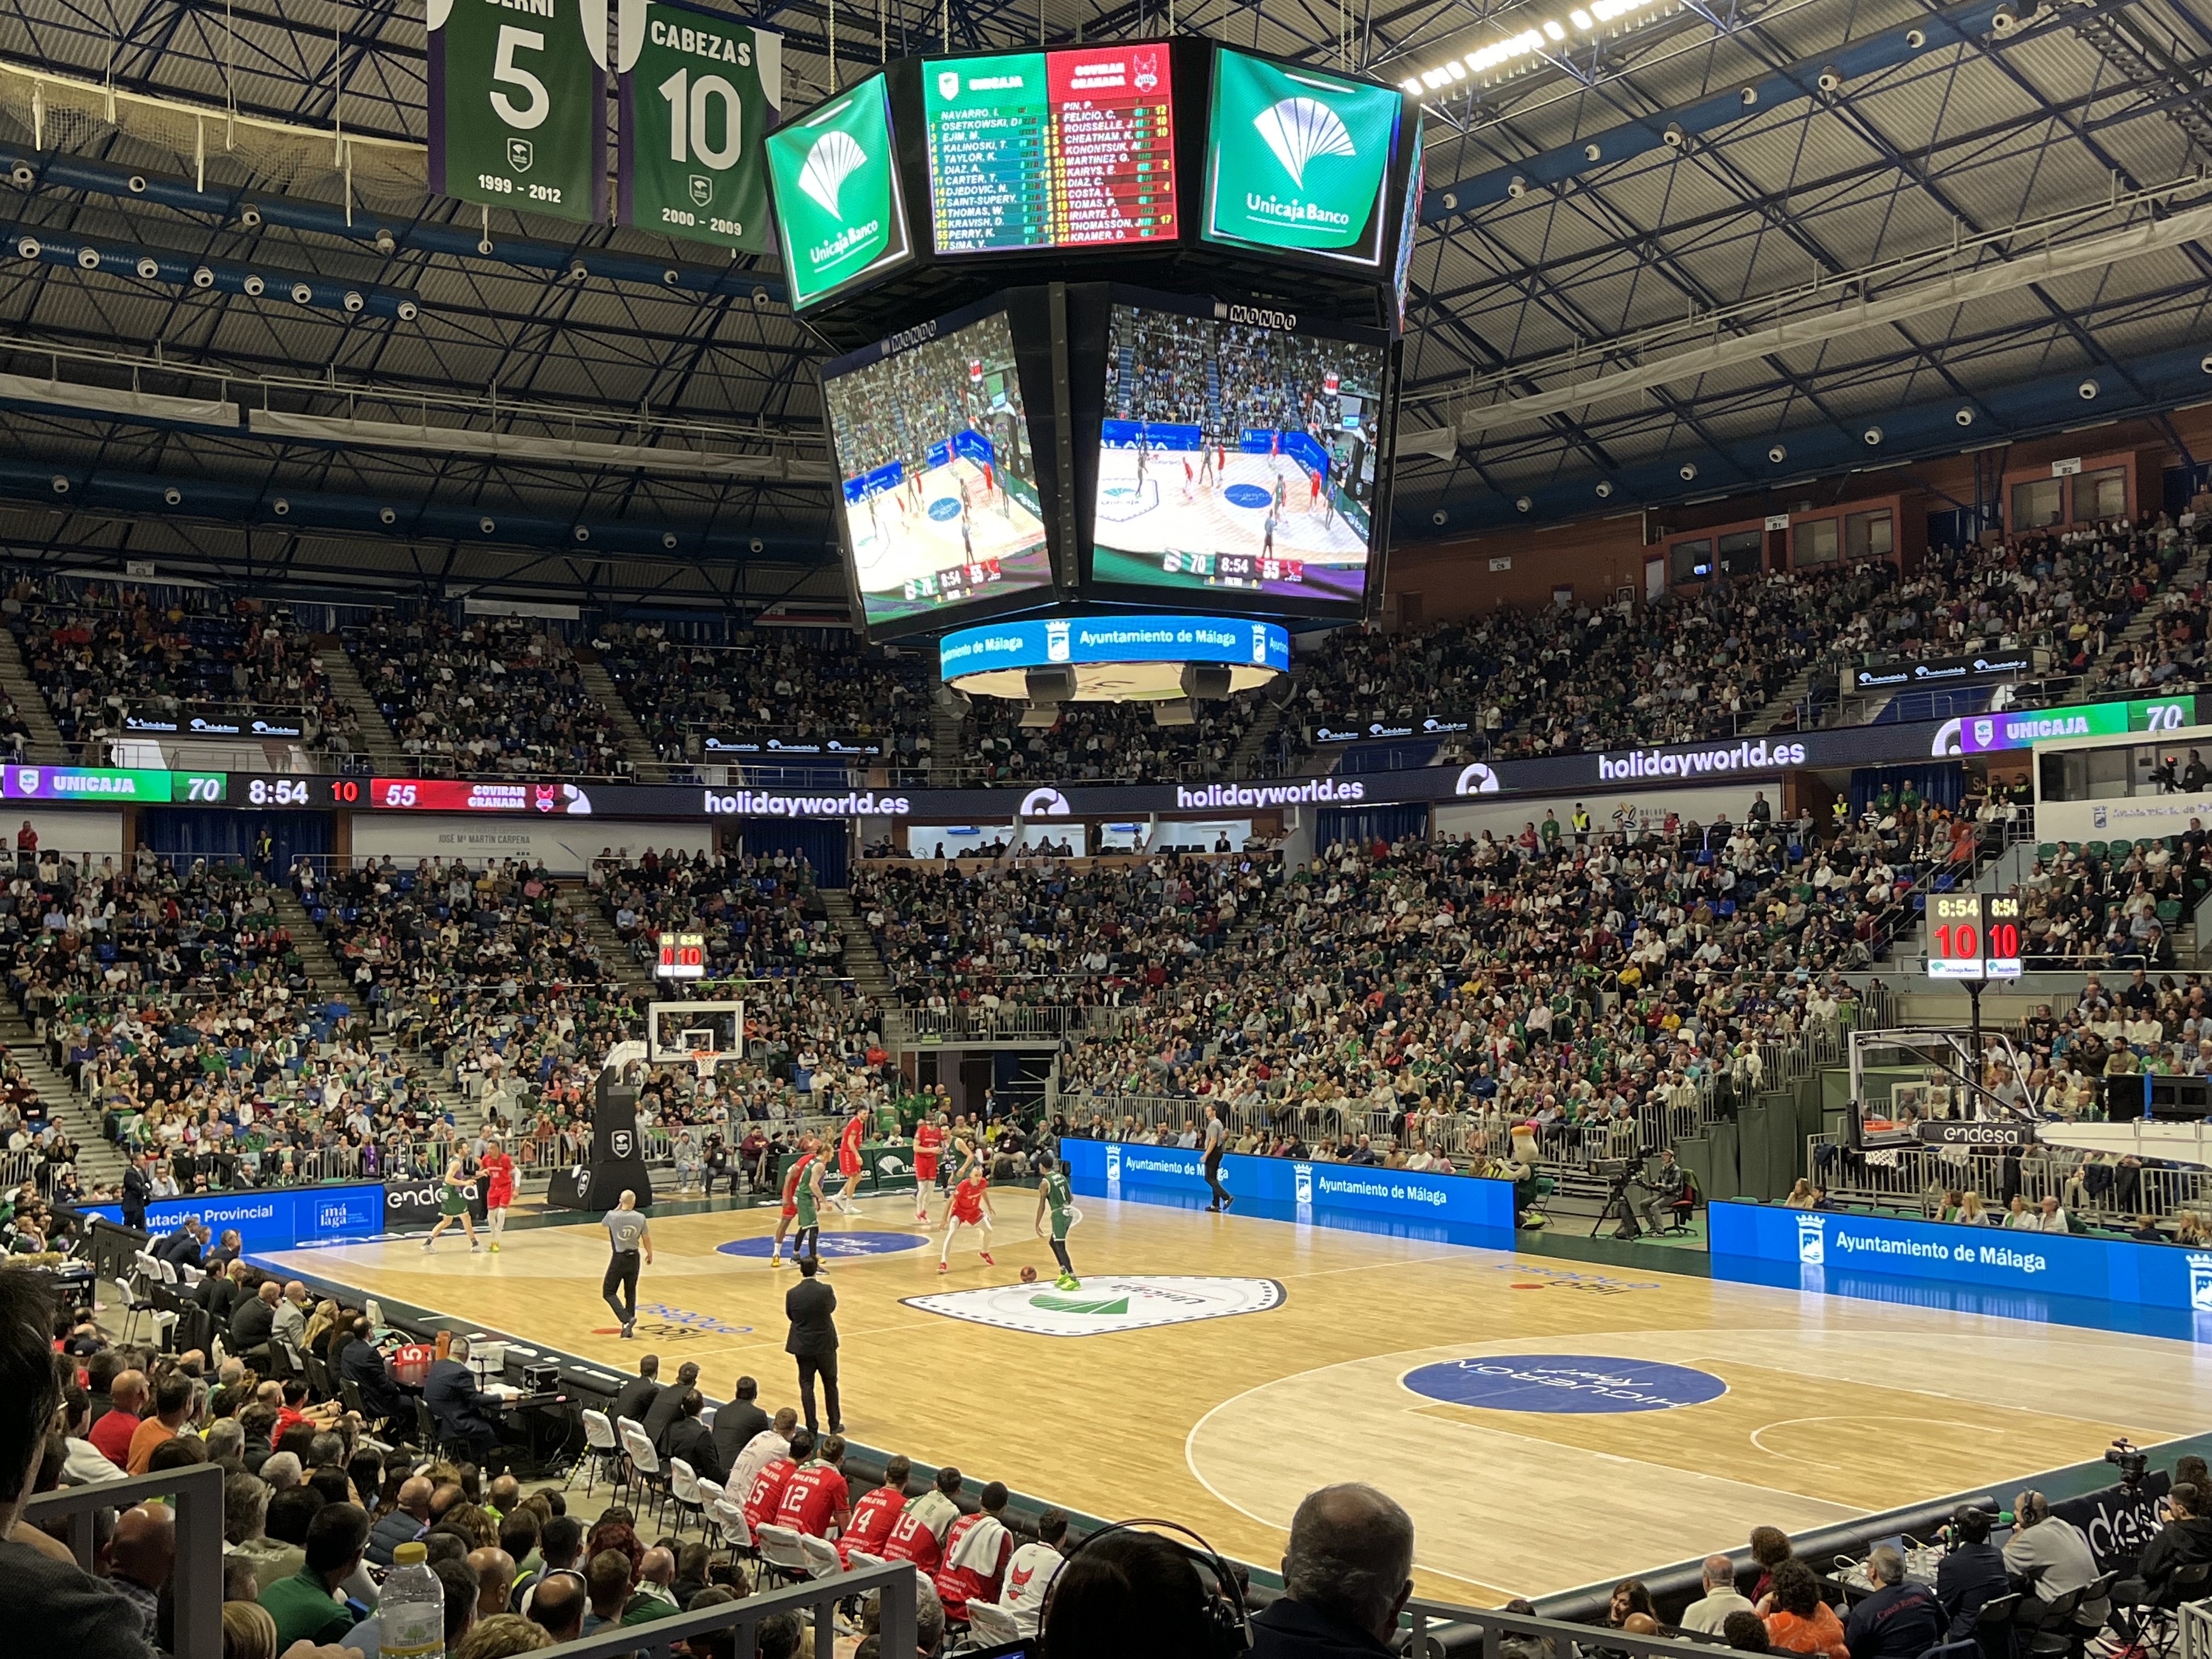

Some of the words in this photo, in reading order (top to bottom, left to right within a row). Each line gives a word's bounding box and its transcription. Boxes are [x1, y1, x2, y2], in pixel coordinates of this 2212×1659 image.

[651, 20, 752, 67] CABEZAS
[490, 25, 549, 129] 5
[658, 67, 741, 170] 10
[478, 174, 512, 193] 1999
[529, 184, 561, 204] 2012
[662, 208, 695, 227] 2000
[710, 217, 742, 236] 2009
[1246, 193, 1305, 221] Unicaja
[1306, 203, 1348, 225] Banco
[810, 232, 849, 263] Unicaja
[848, 219, 878, 245] Banco
[1230, 304, 1296, 330] MONDO
[890, 320, 937, 353] MONDO
[1190, 555, 1206, 573] 70
[1221, 557, 1249, 573] 8:54
[1263, 560, 1279, 579] 55
[973, 641, 984, 654] de
[985, 637, 1023, 652] Málaga
[1080, 629, 1174, 645] Ayuntamiento
[1178, 629, 1193, 643] de
[1195, 629, 1235, 647] Málaga
[2007, 716, 2089, 740] UNICAJA
[2147, 704, 2184, 732] 70
[1599, 740, 1805, 780] holidayworld.es
[54, 775, 136, 794] UNICAJA
[188, 778, 219, 801] 70
[249, 779, 308, 804] 8:54
[331, 781, 358, 802] 10
[386, 784, 416, 806] 55
[467, 796, 526, 808] GRANADA
[704, 790, 910, 817] holidayworld.es
[1177, 778, 1364, 808] holidayworld.es
[438, 833, 454, 843] JOSÉ
[498, 835, 531, 844] CARPENA
[1938, 899, 1978, 917] 8:54
[1991, 899, 2018, 916] 8:54
[1934, 924, 1977, 958] 10
[1989, 924, 2017, 958] 10
[661, 947, 673, 965] 10
[678, 947, 701, 965] 10
[1944, 1125, 2018, 1144] endesa
[1125, 1156, 1183, 1176] Ayuntamiento
[1184, 1161, 1195, 1175] de
[1319, 1177, 1389, 1198] Ayuntamiento
[1391, 1184, 1404, 1199] de
[1407, 1184, 1447, 1205] Málaga
[205, 1204, 273, 1222] Provincial
[1836, 1231, 1950, 1260] Ayuntamiento
[1954, 1239, 1976, 1262] de
[1979, 1246, 2046, 1273] Málaga
[1494, 1263, 1661, 1289] endesa
[1544, 1280, 1632, 1295] liga
[747, 1477, 769, 1505] 15
[791, 1472, 820, 1486] PULEVA
[781, 1484, 809, 1513] 12
[859, 1495, 888, 1507] PULEVA
[847, 1506, 875, 1533] 14
[891, 1513, 920, 1542] 19
